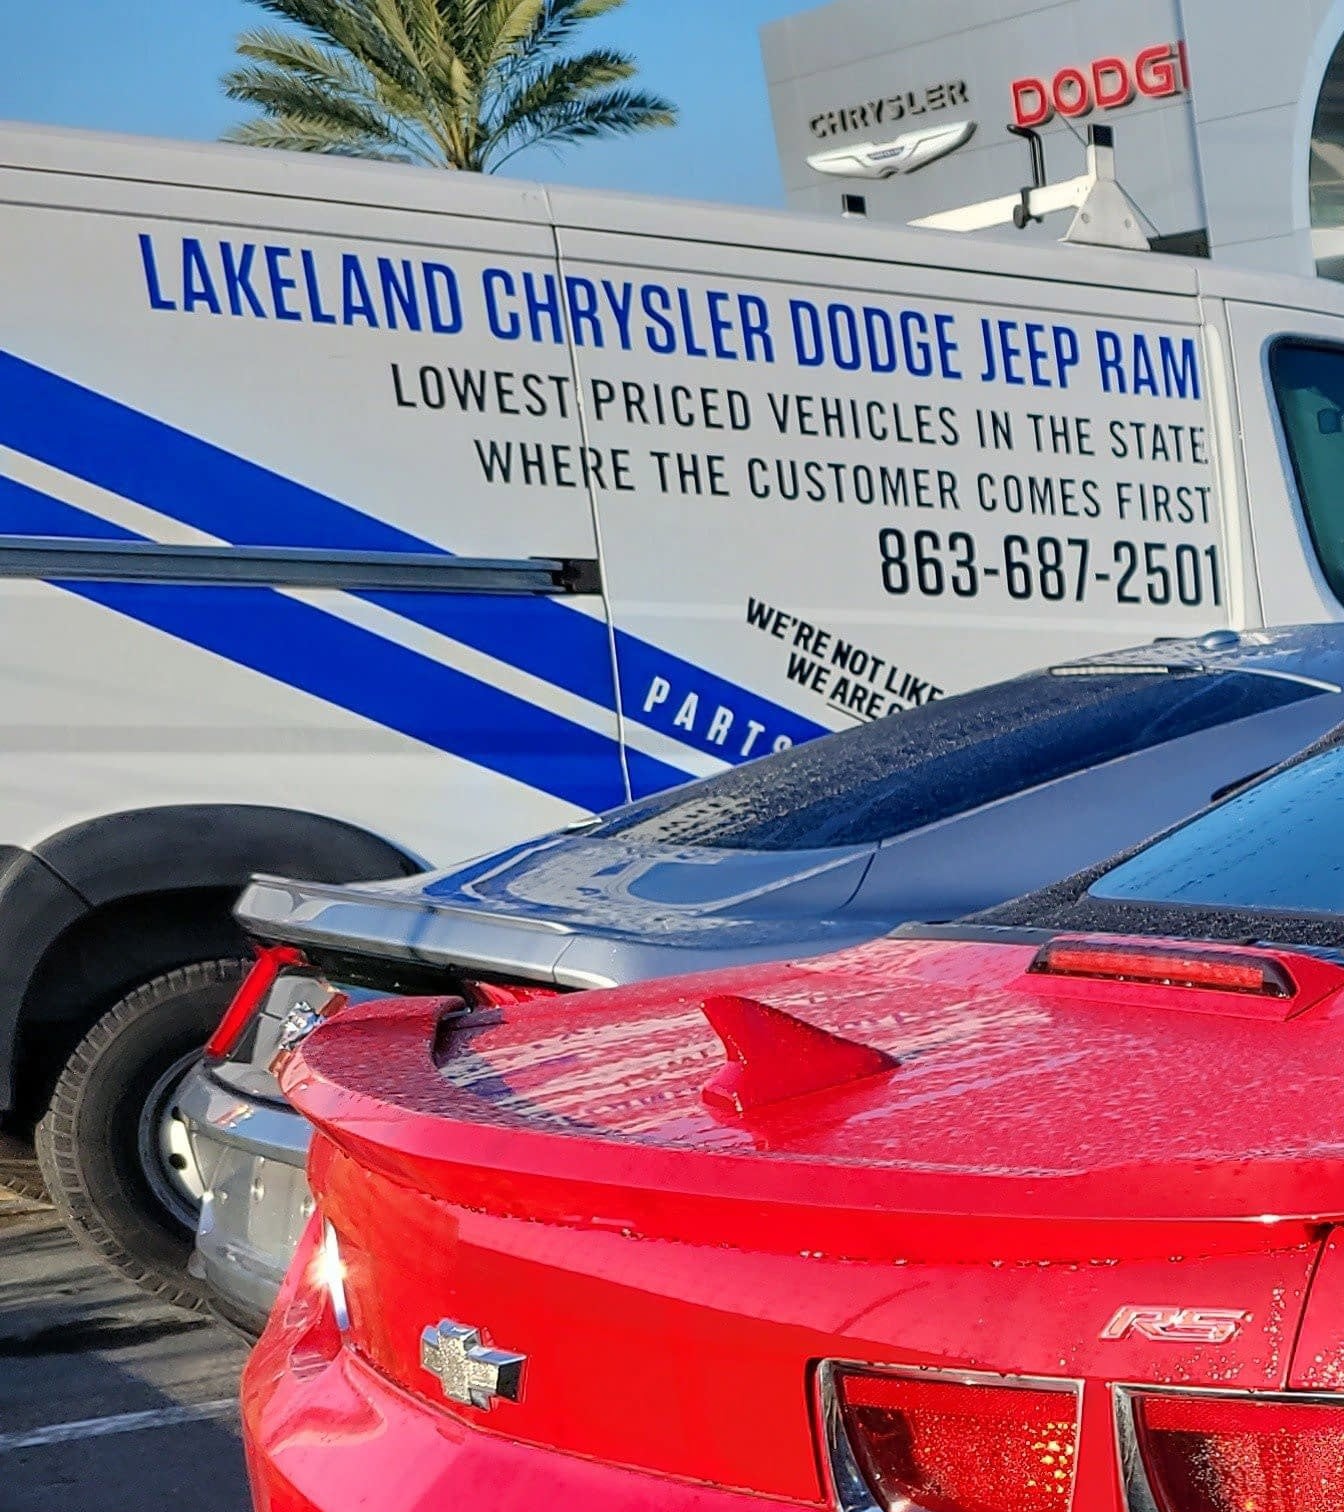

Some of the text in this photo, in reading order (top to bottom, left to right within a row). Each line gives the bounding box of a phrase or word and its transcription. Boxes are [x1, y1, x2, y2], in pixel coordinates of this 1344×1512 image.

[808, 78, 971, 139] CHRYSLER
[139, 234, 1200, 399] LAKELAND CHRYSLER DODGE JEEP RAM
[391, 363, 1208, 465] LOWEST PRICED VEHICLES IN THE STATE
[473, 439, 1212, 524] WHERE THE CUSTOMER COMES FIRST
[878, 527, 1220, 606] 863-687-2501
[746, 597, 832, 659] WE'RE
[830, 639, 885, 684] NOT
[786, 652, 885, 720] WE ARE
[1100, 1304, 1248, 1343] RS
